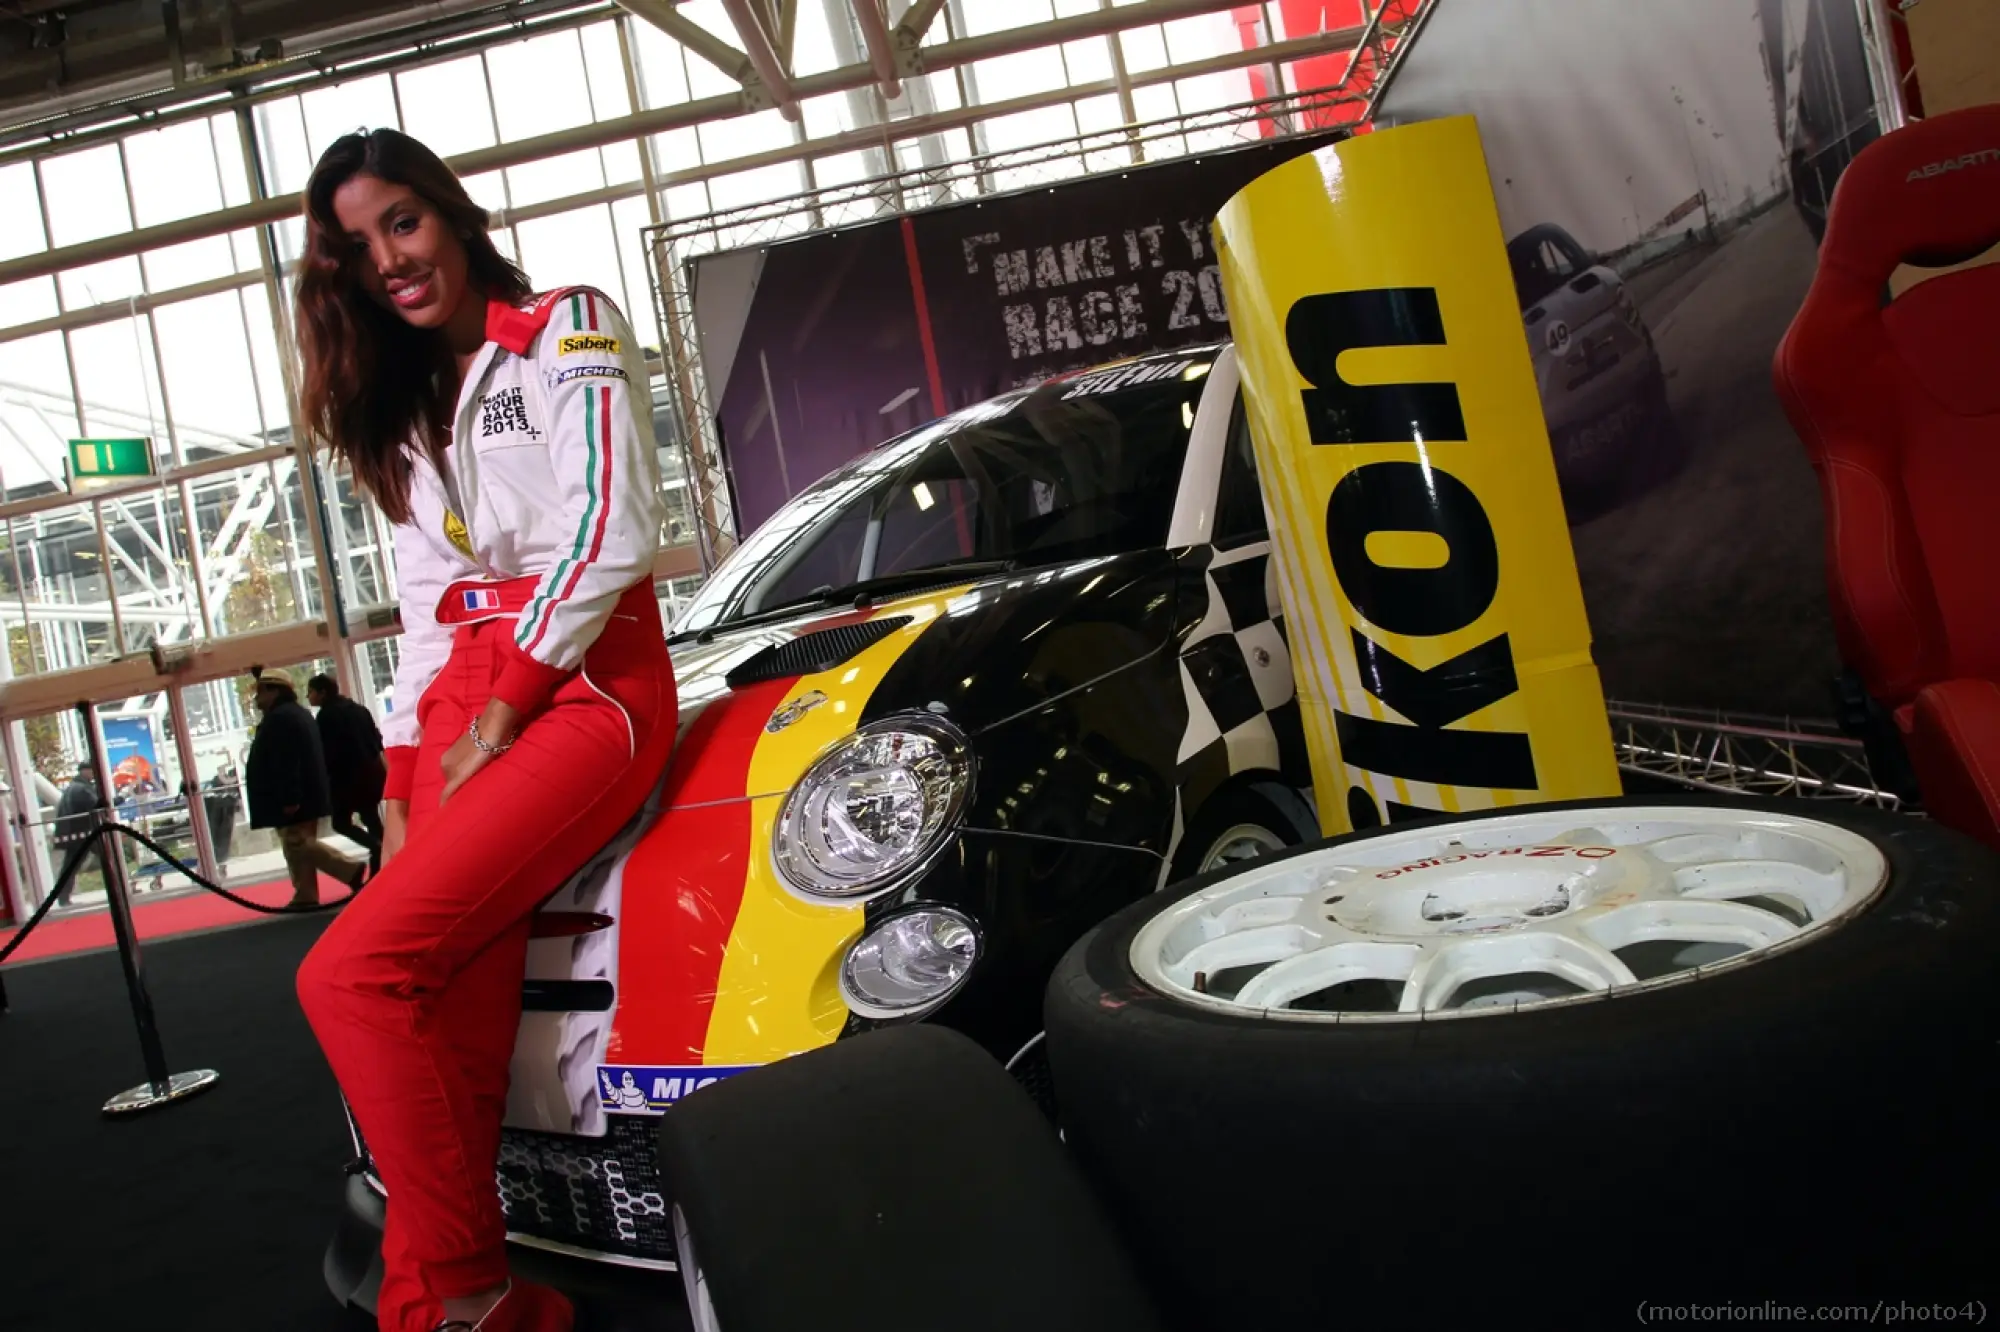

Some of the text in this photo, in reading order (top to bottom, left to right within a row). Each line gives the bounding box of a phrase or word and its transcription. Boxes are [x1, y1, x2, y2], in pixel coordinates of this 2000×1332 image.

[993, 216, 1216, 296] MAKE IT Y
[1003, 282, 1148, 359] RACE
[563, 337, 616, 352] Sabelt
[563, 366, 627, 380] MICHEL
[511, 386, 522, 395] IT
[483, 395, 524, 414] YOUR
[482, 405, 527, 426] RACE
[482, 418, 529, 437] 2013
